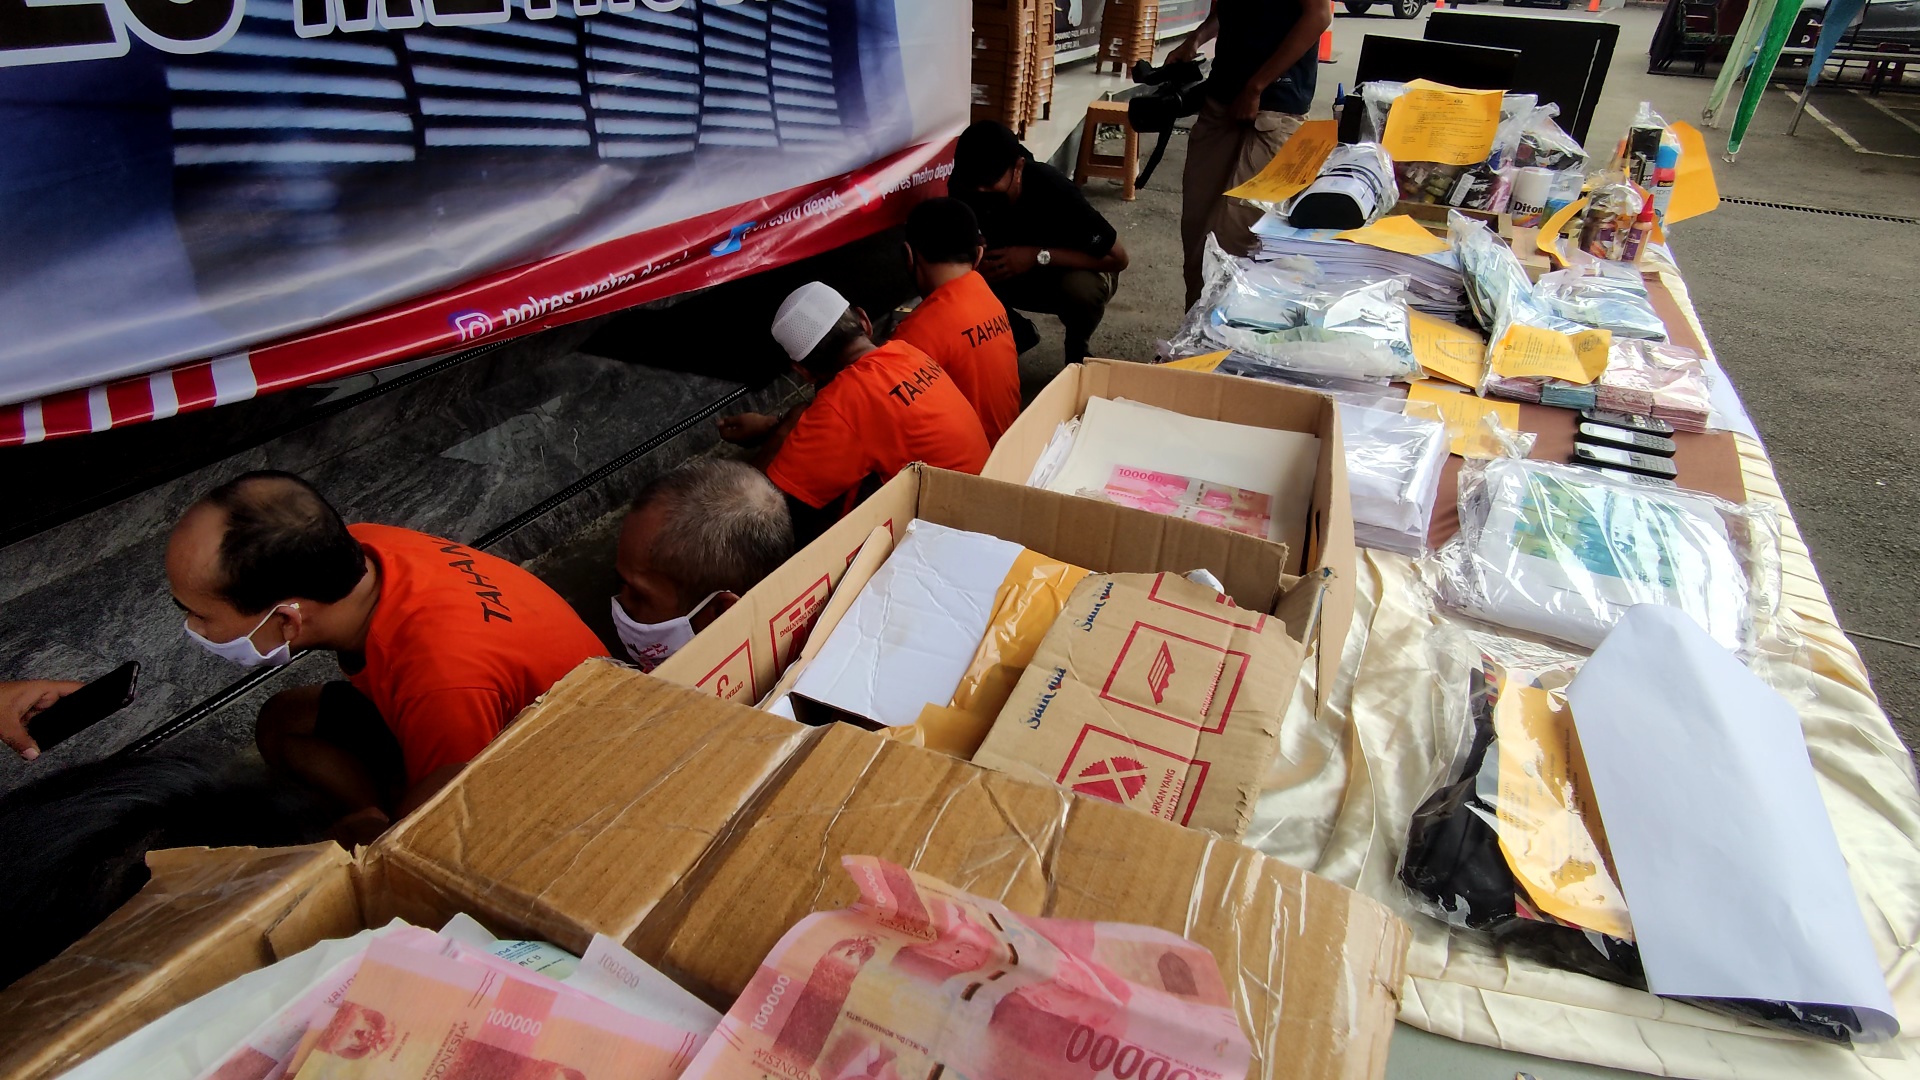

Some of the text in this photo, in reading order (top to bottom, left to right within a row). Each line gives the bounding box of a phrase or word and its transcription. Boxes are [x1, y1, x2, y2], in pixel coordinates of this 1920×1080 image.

[912, 168, 934, 187] metro
[802, 190, 845, 217] depok
[1513, 201, 1544, 213] Diton
[889, 358, 942, 407] TAHAN
[1118, 467, 1163, 484] 100000
[422, 533, 512, 622] TAHAN
[1150, 768, 1176, 817] ARKAN YANG
[598, 952, 640, 990] 100000
[751, 976, 791, 1030] 100000
[487, 1008, 542, 1037] 100000
[430, 1021, 469, 1080] DONESIA
[754, 1047, 822, 1080] NDONESIA
